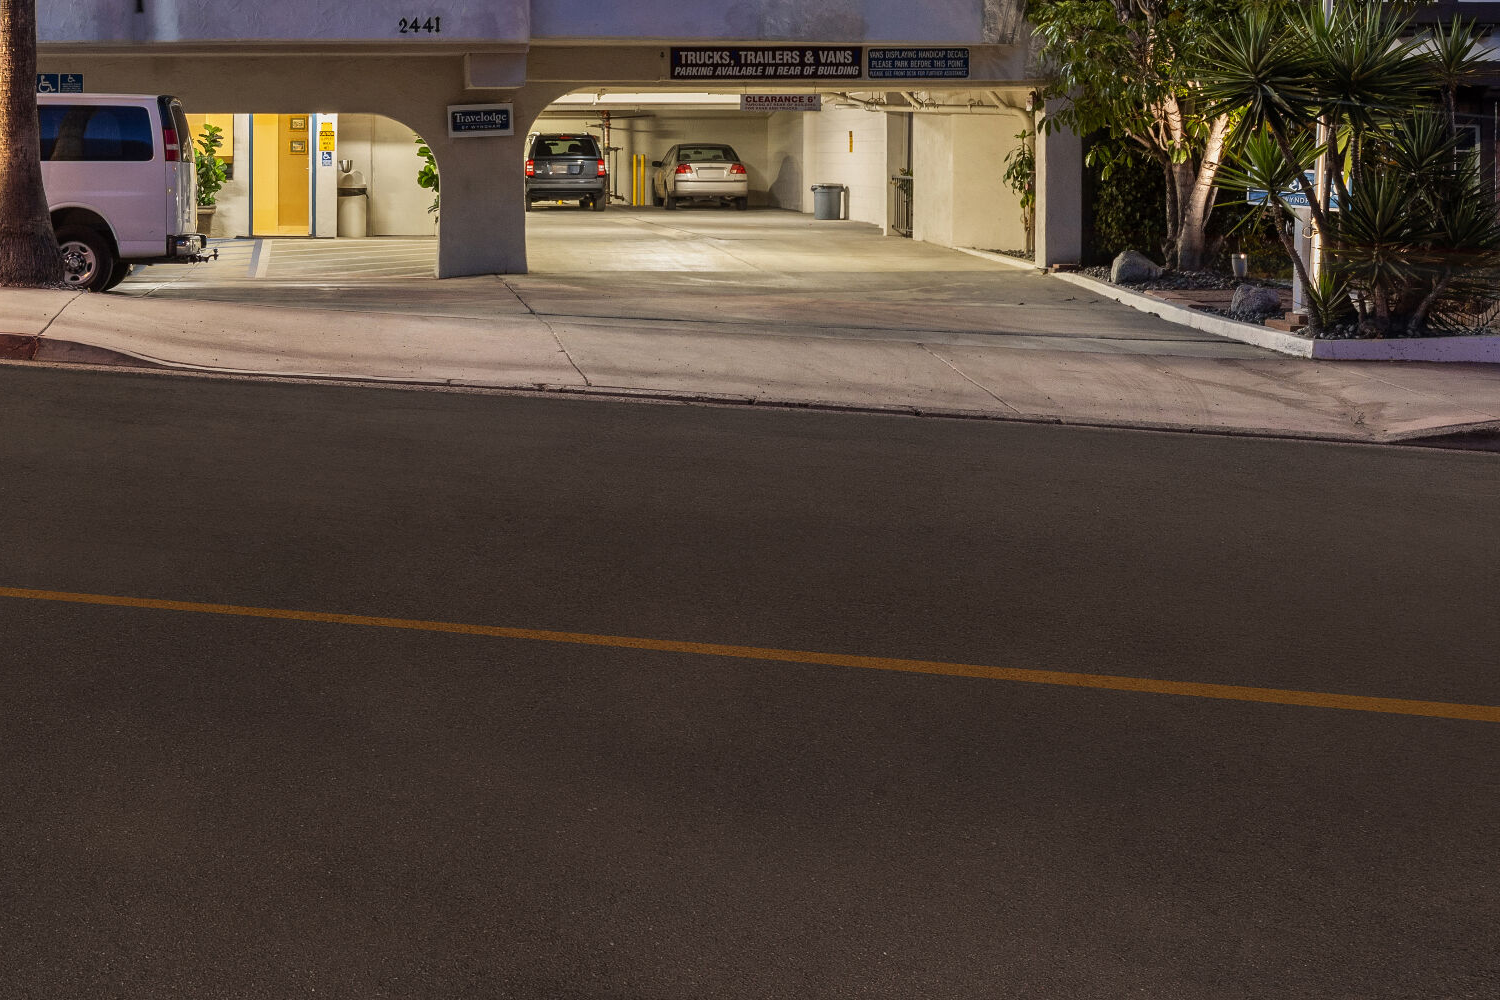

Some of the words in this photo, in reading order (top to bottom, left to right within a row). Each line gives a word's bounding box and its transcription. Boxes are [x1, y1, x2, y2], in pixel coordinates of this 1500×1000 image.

[398, 16, 441, 33] 2441
[679, 51, 734, 66] TRUCKS,
[739, 51, 800, 64] TRAILERS
[804, 50, 814, 64] &
[818, 50, 853, 64] VANS
[947, 50, 968, 58] DECALS
[871, 60, 892, 68] PLEASE
[894, 60, 909, 68] PARK
[910, 60, 932, 68] BEFORE
[933, 60, 945, 68] THIS
[674, 66, 713, 76] PARKING
[715, 66, 763, 75] AVAILABLE
[765, 66, 776, 75] IN
[776, 66, 801, 75] REAR
[803, 66, 815, 75] OF
[817, 66, 859, 75] BUILDING
[454, 111, 507, 124] Travelodge
